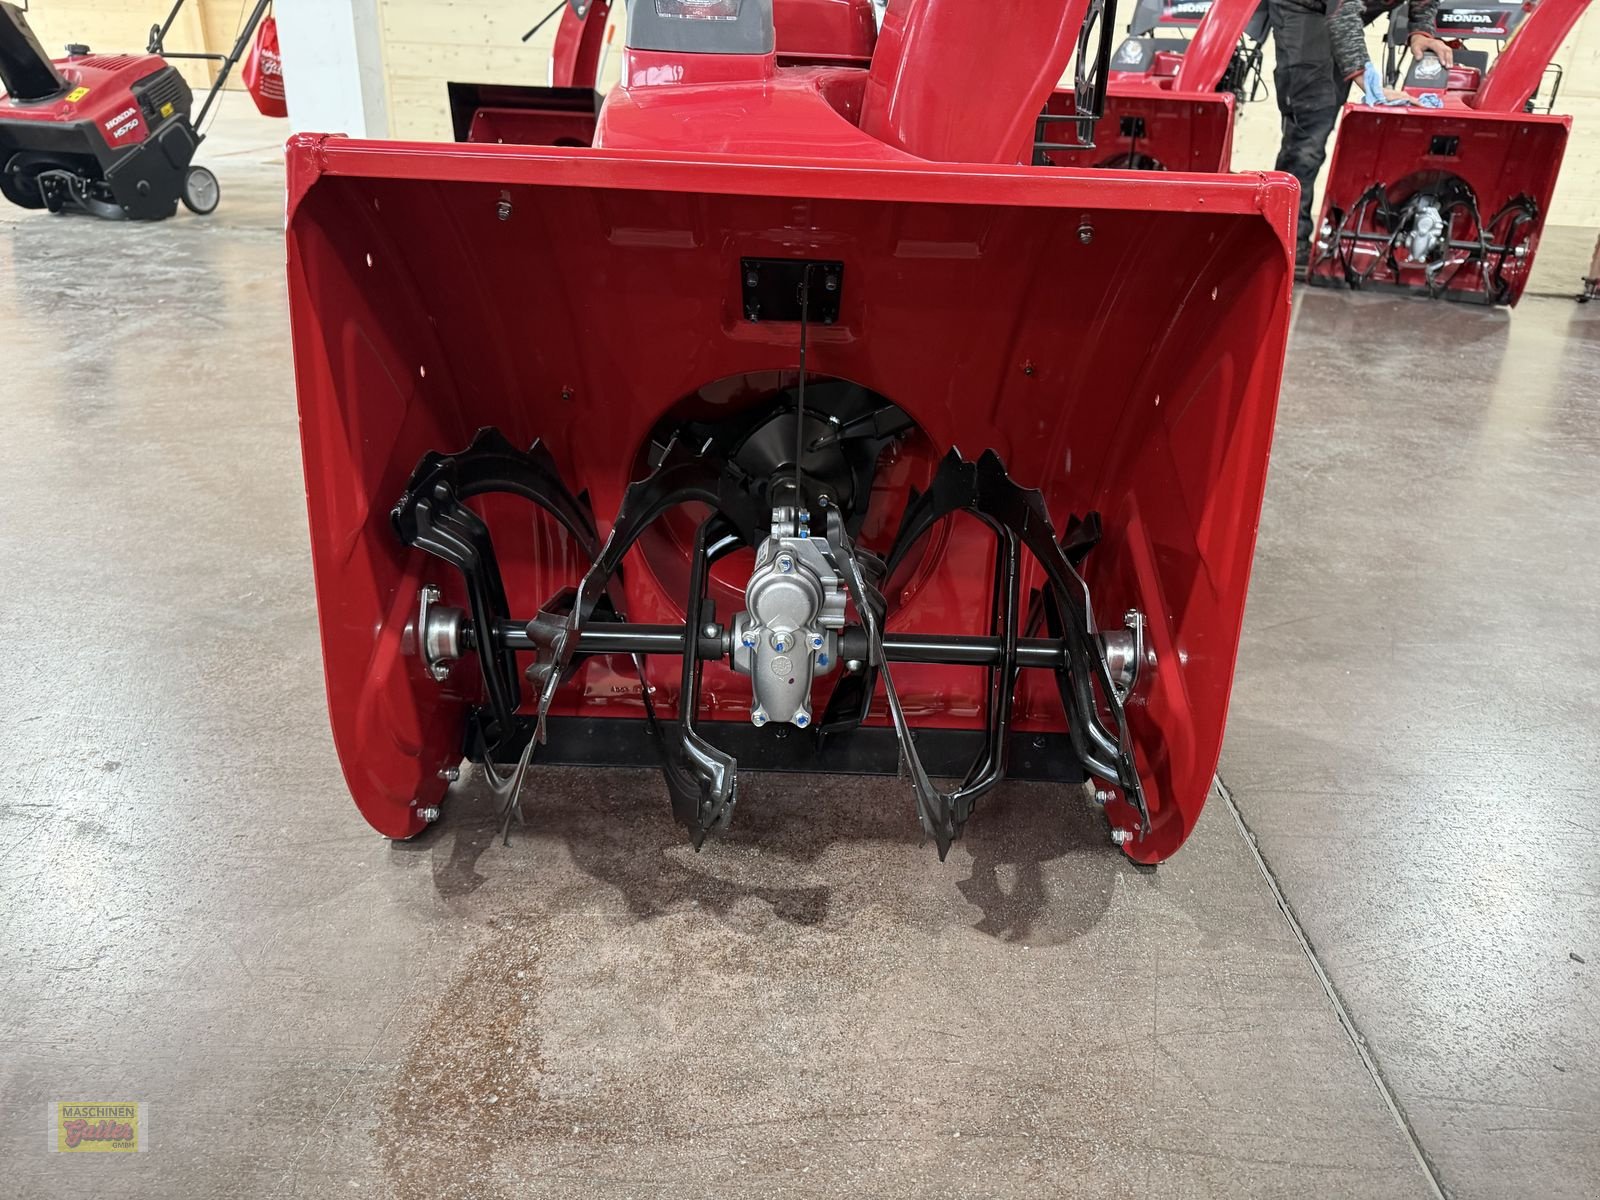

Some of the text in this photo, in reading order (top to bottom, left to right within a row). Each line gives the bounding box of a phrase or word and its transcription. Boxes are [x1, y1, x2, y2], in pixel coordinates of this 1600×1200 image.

[1177, 2, 1209, 13] HON
[1442, 14, 1492, 23] HONDA
[105, 107, 136, 130] HONDA
[113, 118, 138, 138] HS750
